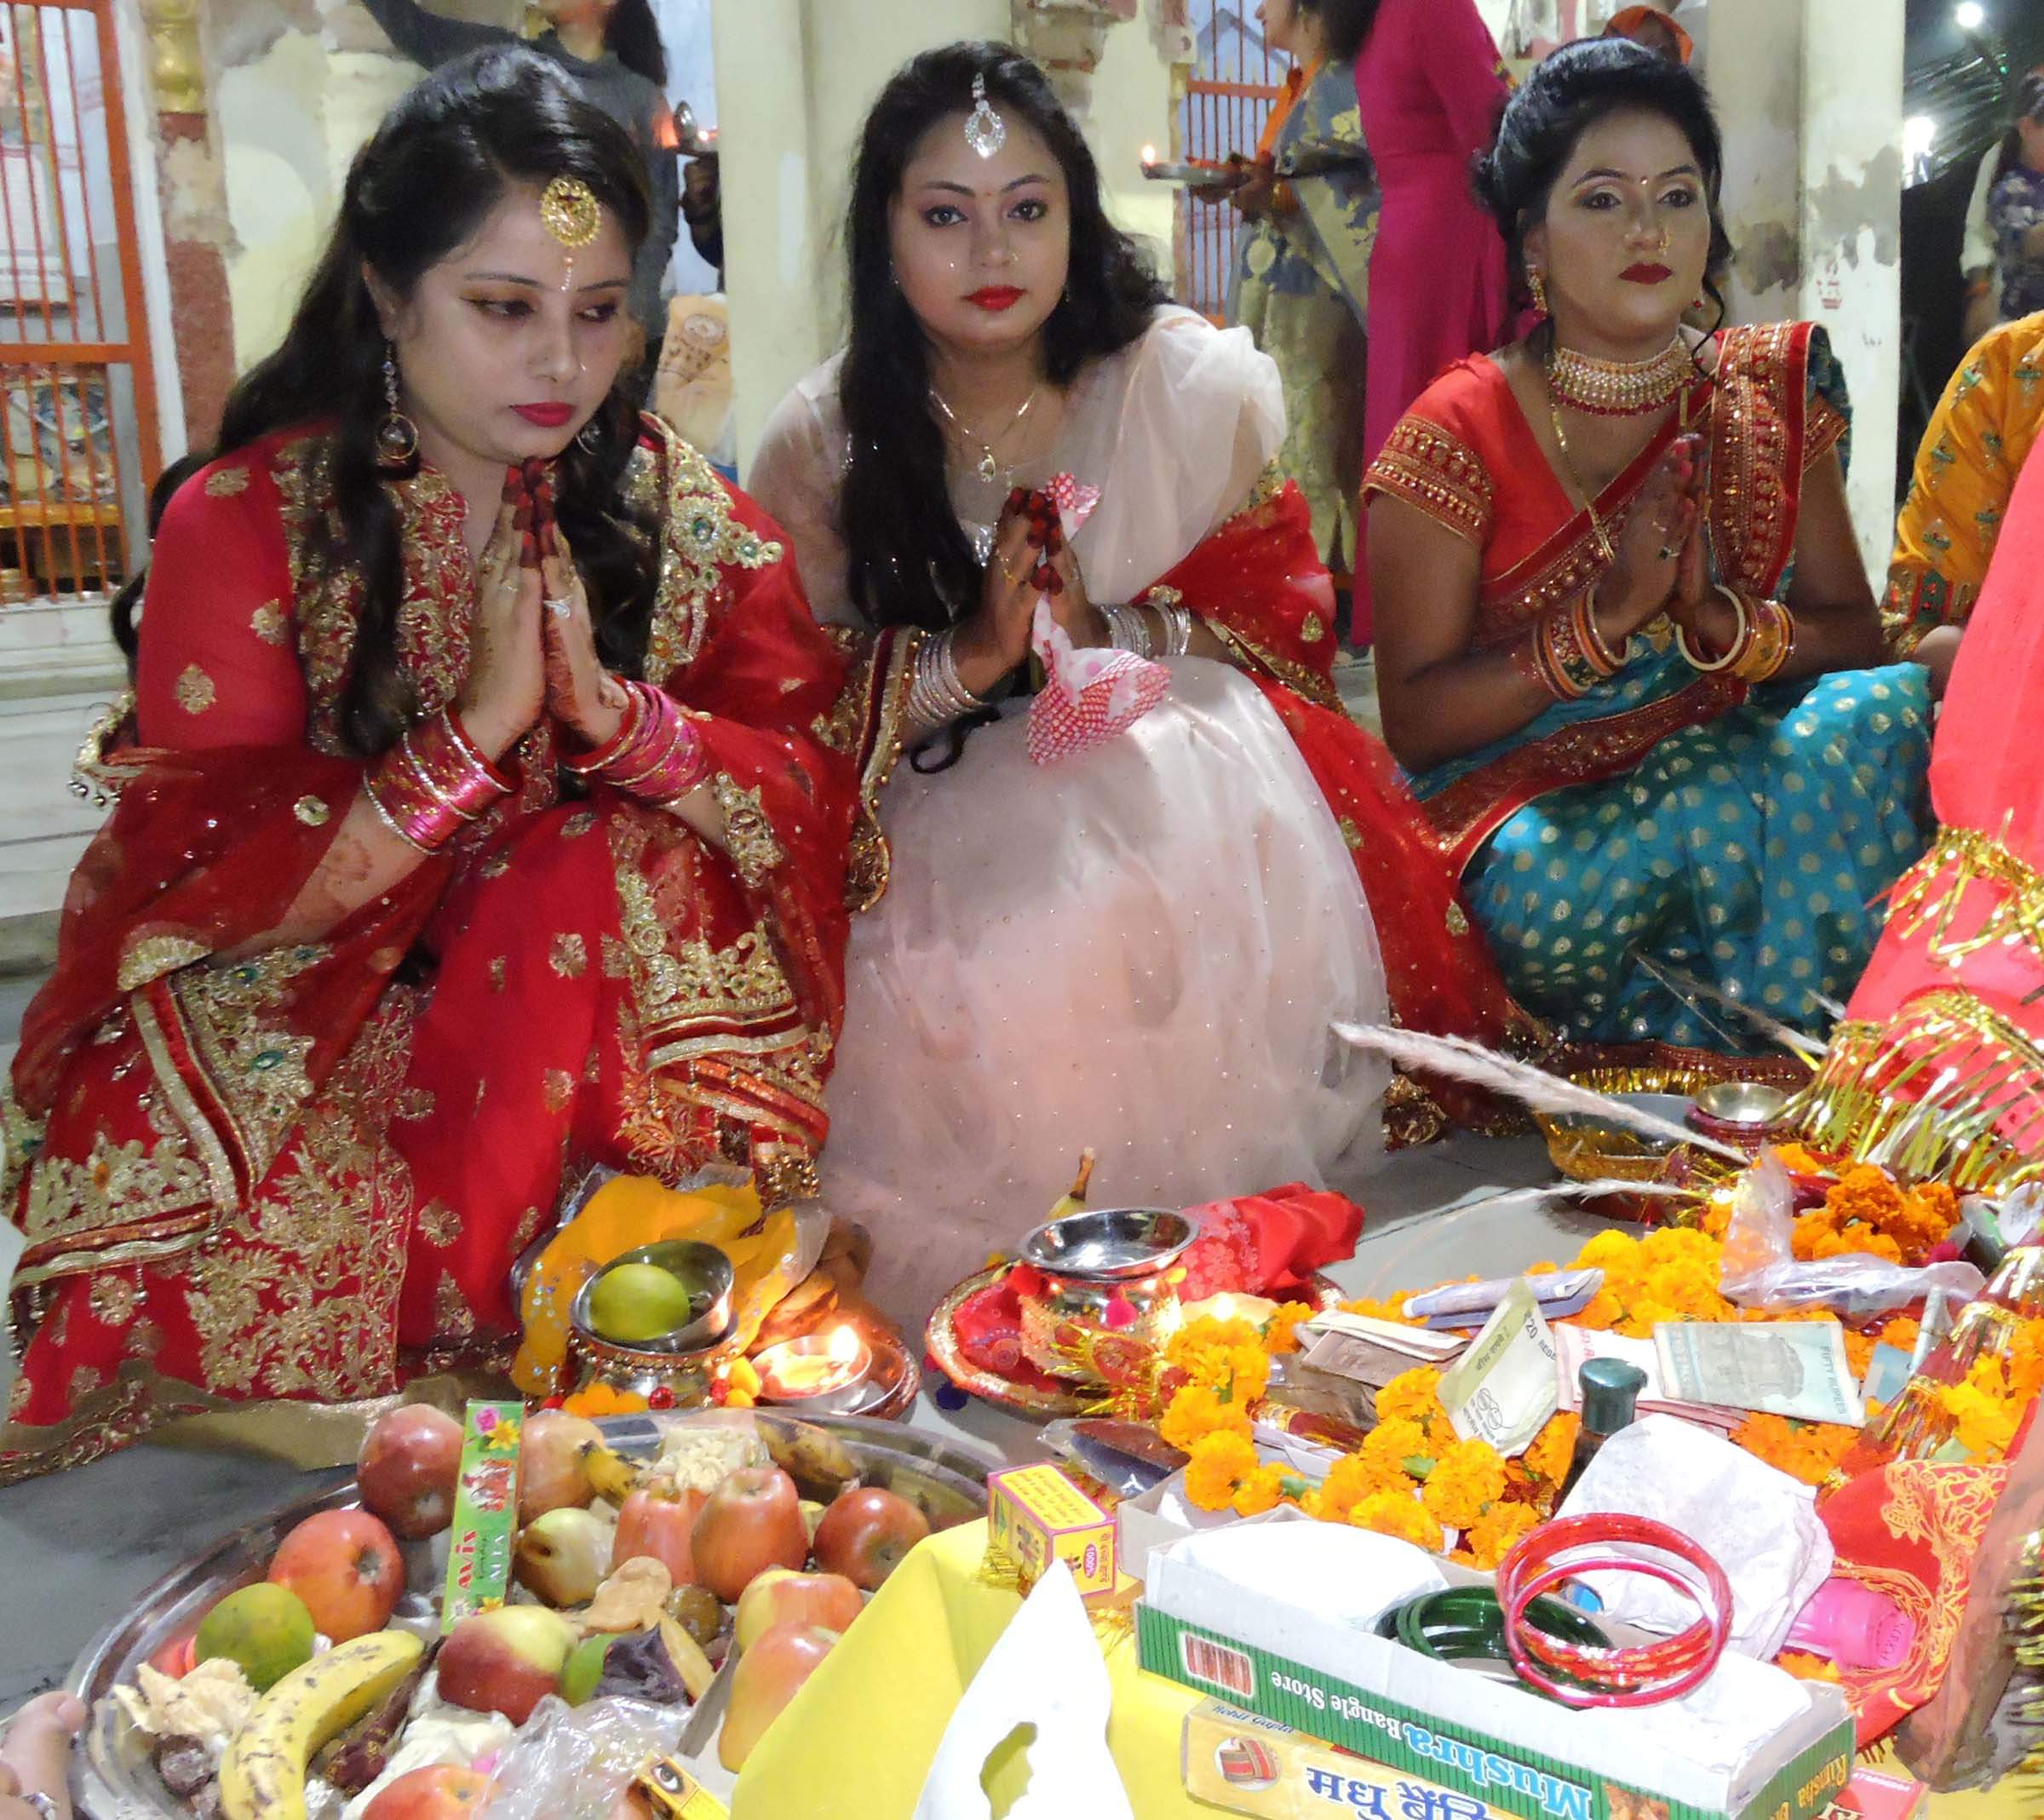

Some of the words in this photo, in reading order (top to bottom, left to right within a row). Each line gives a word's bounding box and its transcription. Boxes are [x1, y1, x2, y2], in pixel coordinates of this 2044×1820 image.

[1271, 1671, 1325, 1710] Store
[1331, 1695, 1402, 1740] Bangle
[1404, 1722, 1592, 1820] Mushra
